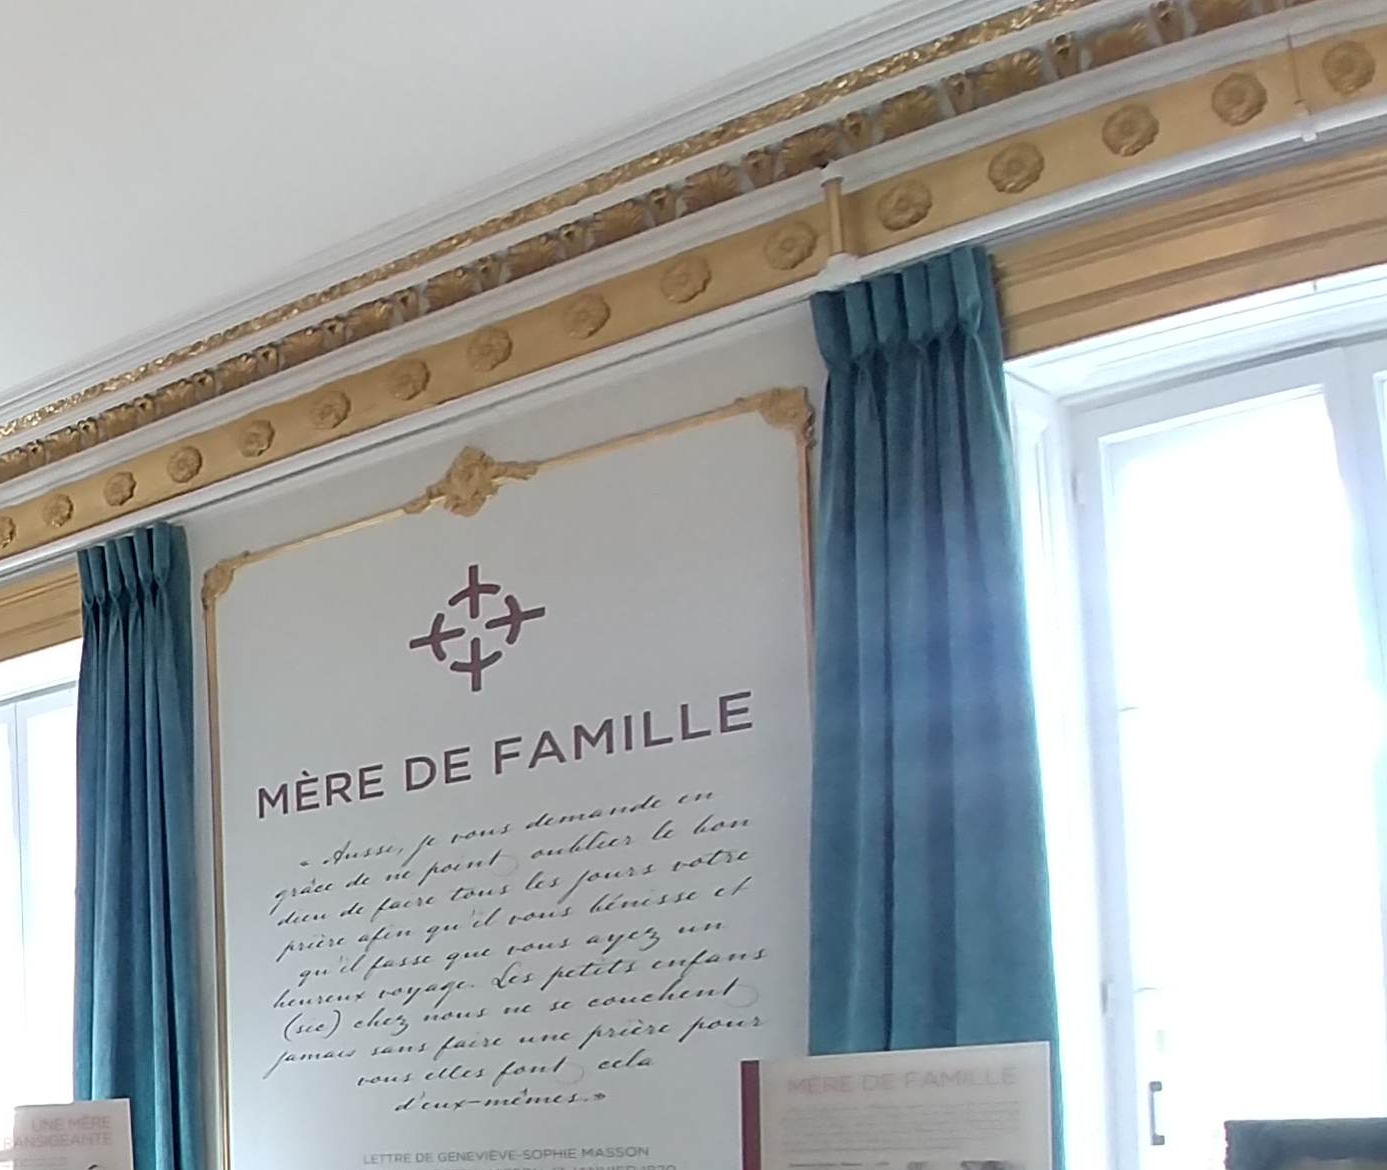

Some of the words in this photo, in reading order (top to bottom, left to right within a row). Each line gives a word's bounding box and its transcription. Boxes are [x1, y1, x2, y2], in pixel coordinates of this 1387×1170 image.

[258, 763, 385, 819] MÈRE
[405, 747, 473, 792] DE
[495, 691, 754, 774] FAMILLE
[402, 835, 436, 868] je
[450, 823, 511, 844] vous
[525, 795, 662, 829] demande
[677, 791, 714, 804] en
[270, 878, 333, 915] grâce
[345, 873, 370, 888] de
[385, 870, 414, 882] ne
[418, 849, 507, 886] point
[530, 830, 634, 859] oublier
[652, 819, 676, 841] le
[693, 813, 750, 835] bon
[277, 911, 327, 926] dieu
[339, 902, 365, 917] de
[370, 896, 435, 923] faire
[450, 884, 509, 901] tous
[525, 871, 560, 890] les
[557, 864, 654, 904] jours
[672, 849, 750, 872] votre
[276, 933, 345, 963] prière
[357, 926, 414, 952] afin
[425, 907, 503, 944] qu'il
[508, 906, 572, 926] vous
[589, 893, 698, 913] bénisse
[713, 876, 752, 897] et
[273, 989, 366, 1008] heureux
[378, 979, 475, 1009] voyage.
[491, 961, 533, 984] Les
[540, 959, 635, 991] petits
[651, 949, 765, 978] enfans
[298, 954, 367, 988] qu'il
[364, 955, 431, 981] fasse
[444, 947, 491, 971] que
[506, 937, 570, 956] vous
[585, 926, 660, 955] ayez
[677, 921, 723, 934] un
[284, 1009, 341, 1042] (sic)
[353, 1007, 409, 1036] chez
[423, 1007, 487, 1023] nous
[504, 1003, 531, 1014] ne
[549, 1000, 572, 1012] se
[587, 977, 741, 1008] couchent
[263, 1050, 356, 1080] jamais
[371, 1042, 428, 1057] sans
[433, 1035, 503, 1061] faire
[519, 1032, 571, 1044] une
[578, 1019, 670, 1050] prière
[678, 1016, 764, 1043] pour
[357, 1072, 414, 1087] vous
[424, 1065, 485, 1080] elles
[492, 1056, 569, 1087] font
[597, 1048, 653, 1070] cela
[787, 1074, 853, 1094] MÈRE
[863, 1073, 894, 1092] DE
[905, 1066, 1017, 1089] FAMILLE
[32, 1119, 64, 1132] UNE
[68, 1115, 111, 1130] MÈRE
[363, 1153, 411, 1165] LETTRE
[416, 1152, 433, 1163] DE
[581, 1146, 649, 1158] MASSON
